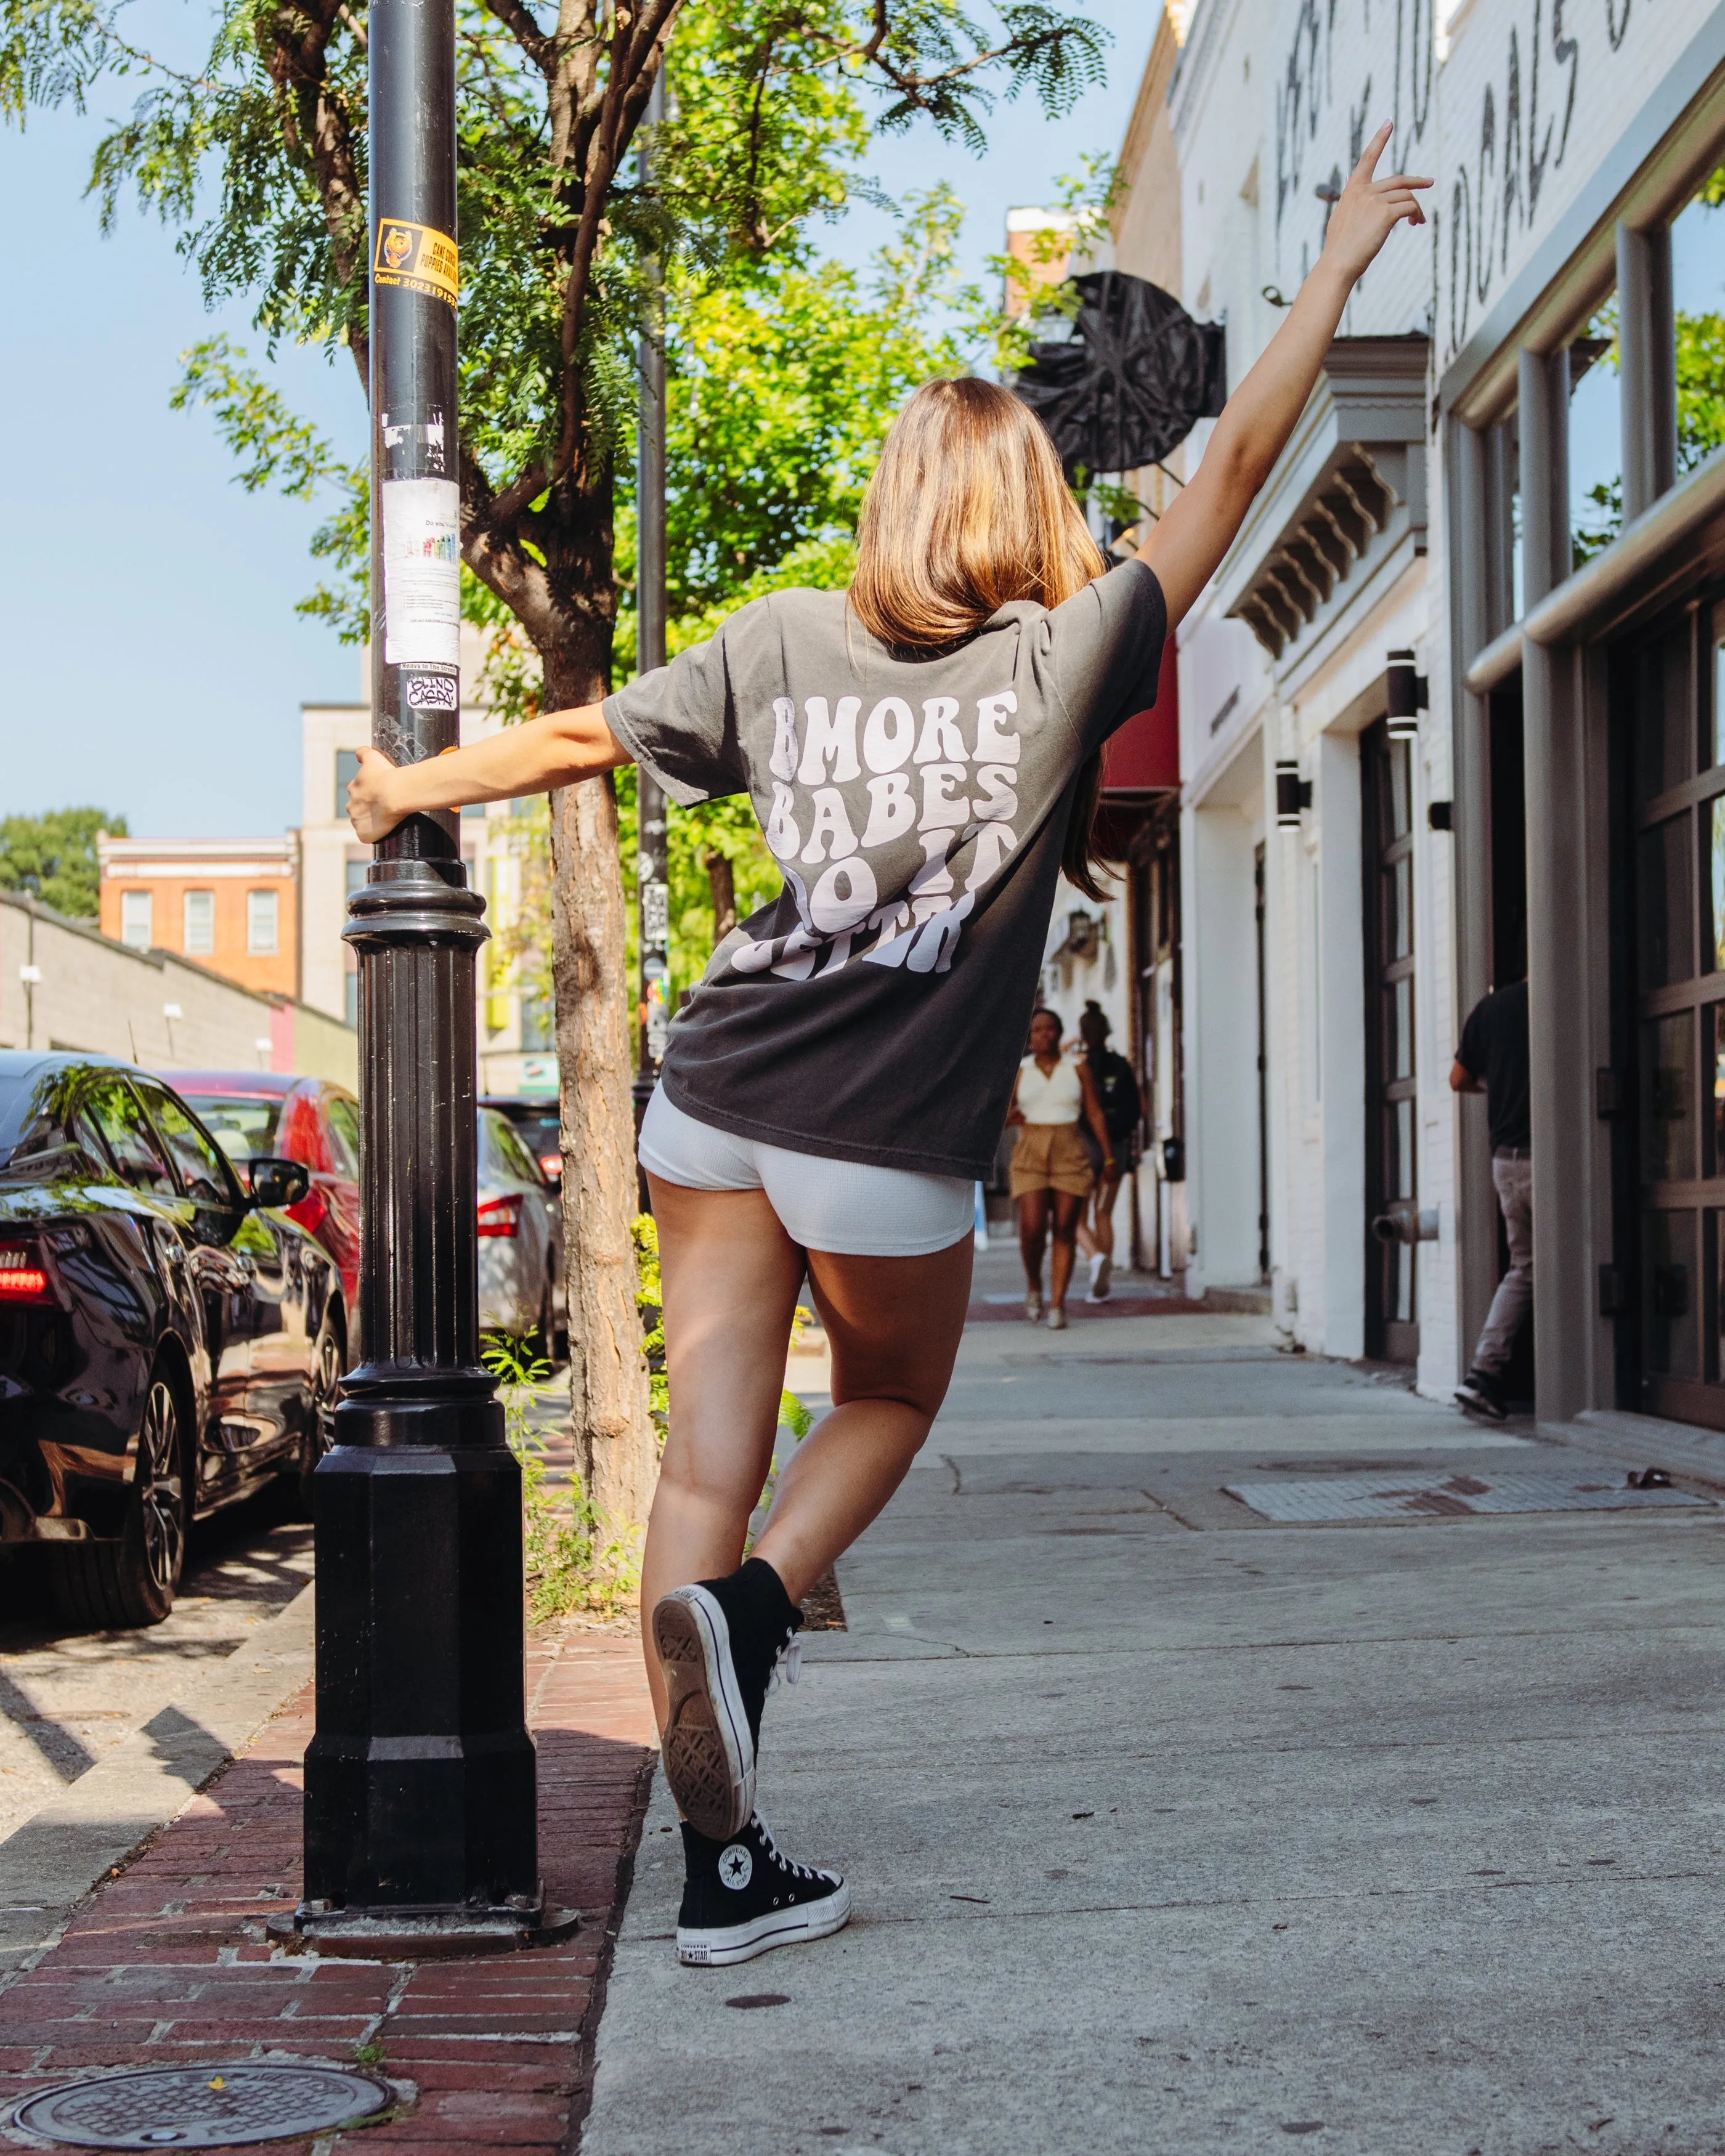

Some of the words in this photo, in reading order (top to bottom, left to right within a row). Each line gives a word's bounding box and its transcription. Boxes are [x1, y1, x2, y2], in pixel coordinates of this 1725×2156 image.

[420, 254, 443, 273] PUPPIES
[375, 273, 400, 286] Contact
[769, 691, 1021, 785] BMORE
[766, 763, 1018, 863] BABES
[909, 821, 1018, 895] IT
[722, 1847, 749, 1864] CONVERSE
[694, 1950, 707, 1960] STAR
